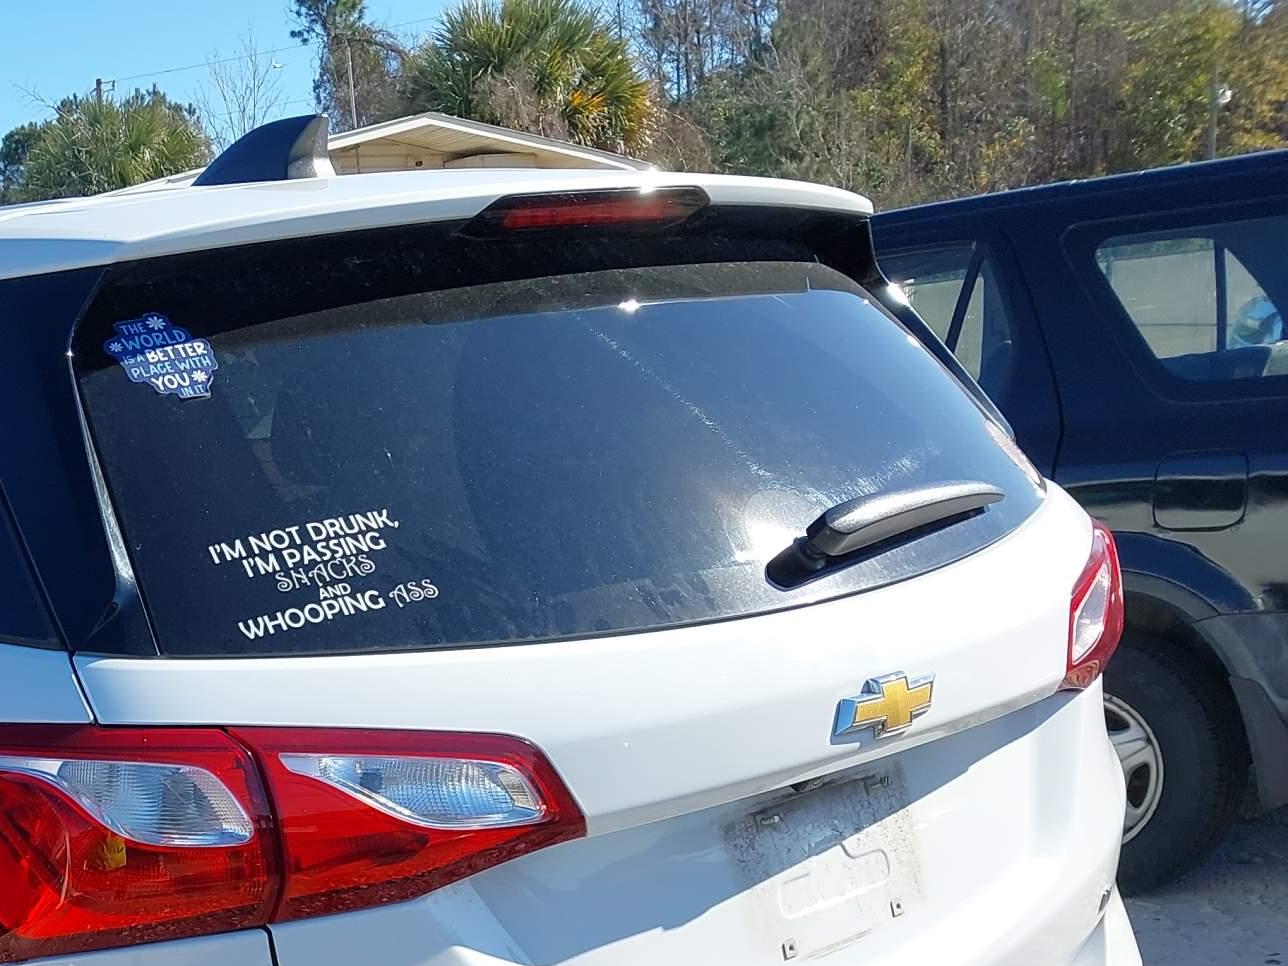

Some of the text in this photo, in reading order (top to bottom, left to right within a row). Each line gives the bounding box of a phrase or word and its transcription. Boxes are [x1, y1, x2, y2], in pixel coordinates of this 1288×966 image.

[119, 322, 147, 336] THE
[121, 330, 186, 351] WORLD
[122, 342, 207, 365] IS A BETTER
[131, 356, 212, 379] PLACE WITH
[150, 372, 190, 391] YOU
[181, 385, 205, 397] IN IT
[208, 508, 400, 565] I'M NOT DRUNK,
[241, 531, 388, 578] I'M PASSING
[275, 553, 376, 592] SNACKS
[319, 582, 352, 600] AND
[238, 578, 439, 640] WHOOPING ASS
